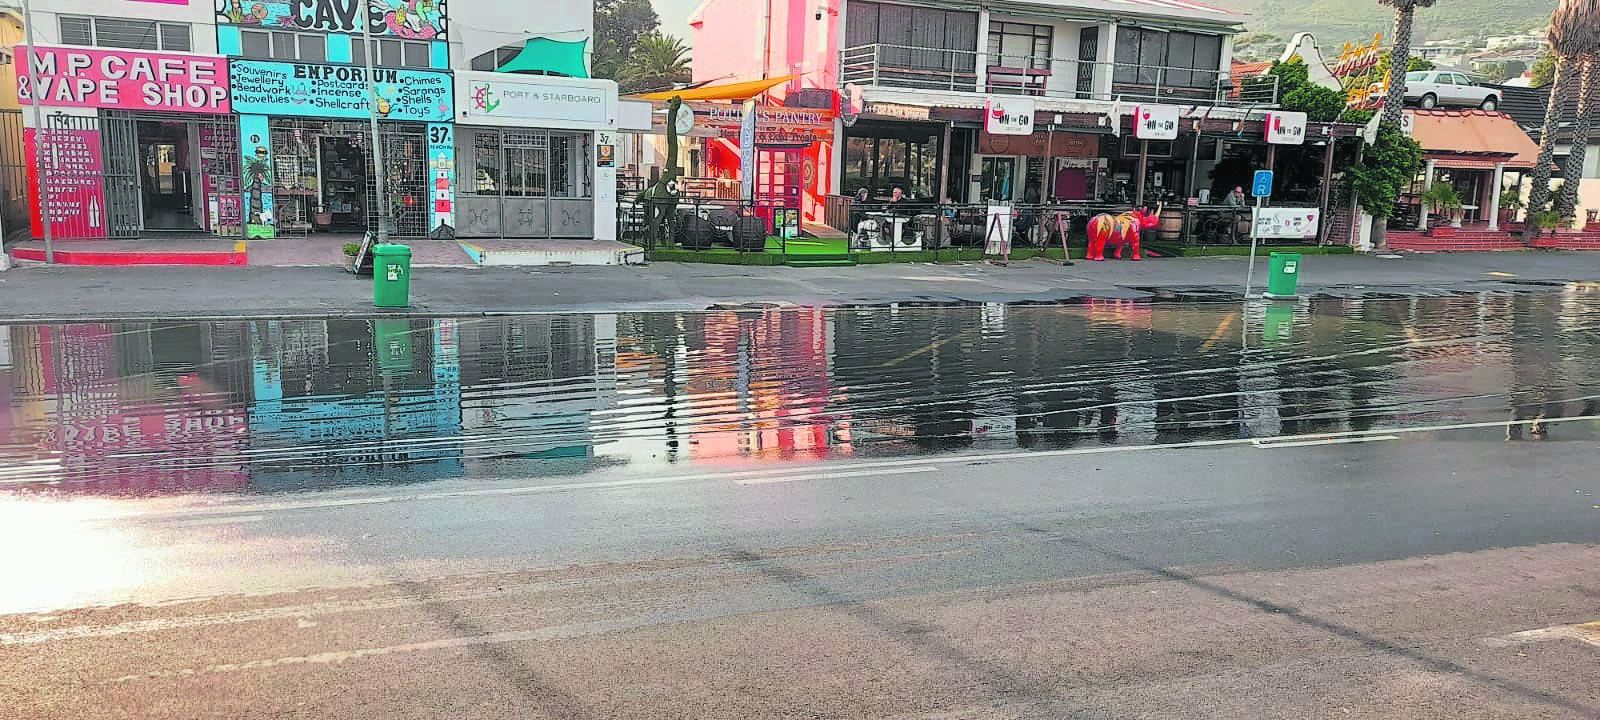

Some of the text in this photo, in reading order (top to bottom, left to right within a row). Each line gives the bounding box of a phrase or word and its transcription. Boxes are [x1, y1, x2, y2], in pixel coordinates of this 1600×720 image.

[290, 0, 388, 33] CAVE
[100, 56, 217, 86] CAFE
[236, 64, 288, 80] Souvenirs
[293, 65, 398, 84] EMPORIUM
[235, 74, 284, 87] Jewellery
[317, 79, 369, 90] Postcards
[404, 76, 441, 86] Chimes
[237, 83, 291, 95] Beadwork
[317, 87, 362, 98] Incense
[403, 86, 446, 97] Sarongs
[142, 82, 228, 109] SHOP
[239, 94, 290, 105] Novelties
[401, 94, 432, 106] Shells
[503, 90, 529, 99] PORT
[542, 93, 601, 104] STARBOARD
[315, 97, 370, 111] Shellcraft
[402, 105, 431, 118] Toys
[710, 107, 823, 125] POTT'S PANTRY
[1018, 115, 1029, 126] GO
[1147, 120, 1157, 130] ON
[1164, 120, 1174, 130] GO
[599, 133, 610, 145] 37
